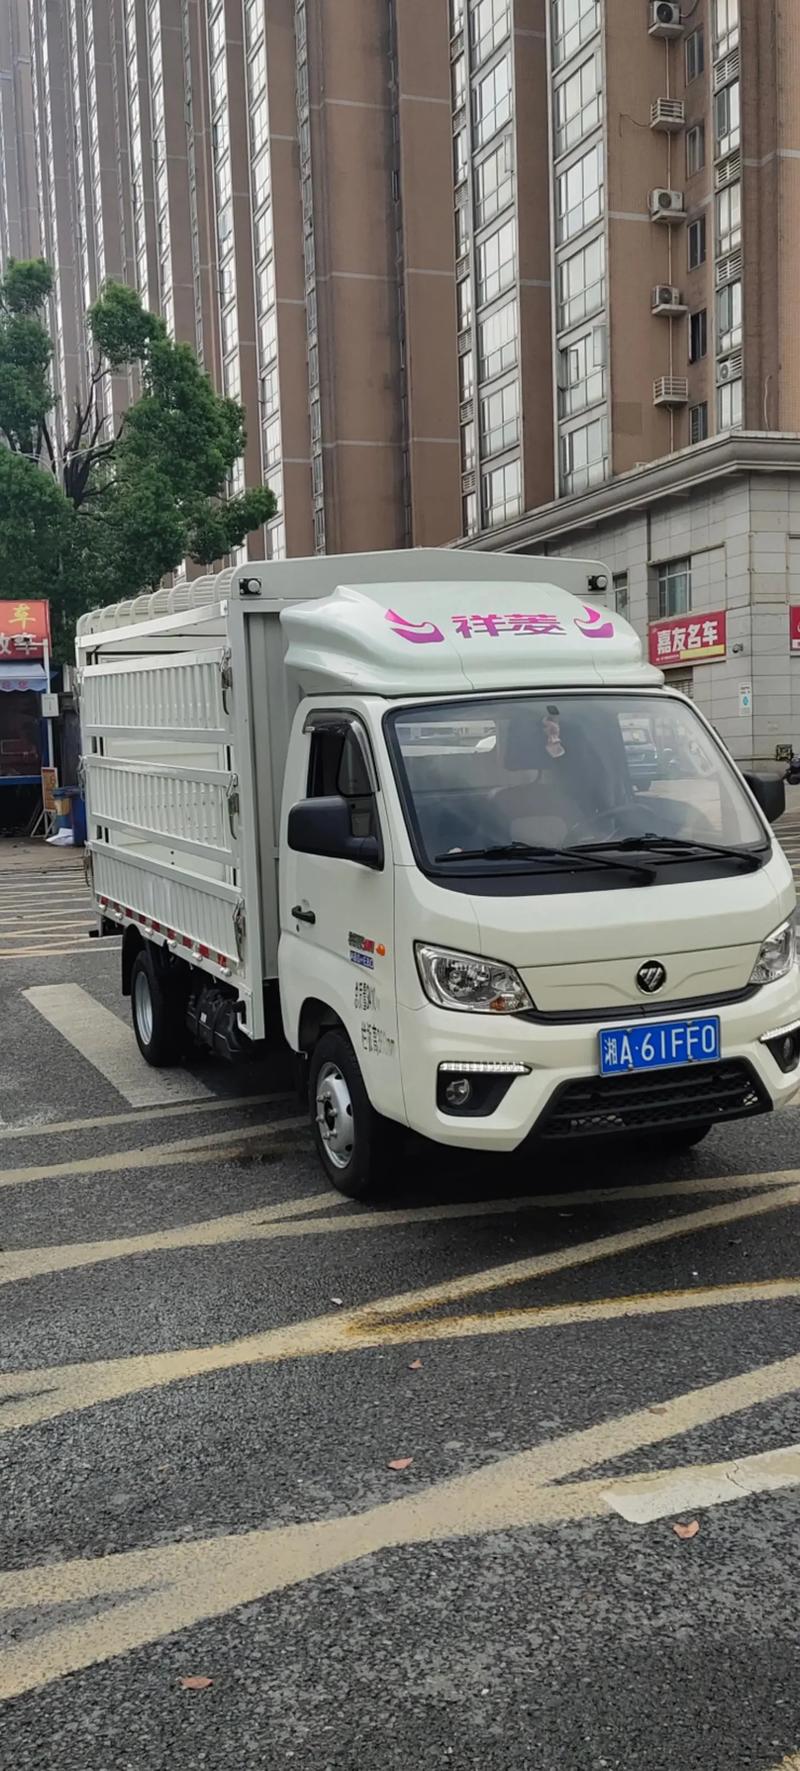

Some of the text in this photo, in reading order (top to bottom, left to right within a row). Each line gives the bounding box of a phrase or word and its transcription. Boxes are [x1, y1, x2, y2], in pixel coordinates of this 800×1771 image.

[451, 613, 567, 639] 祥菱
[656, 621, 718, 655] 嘉友名车
